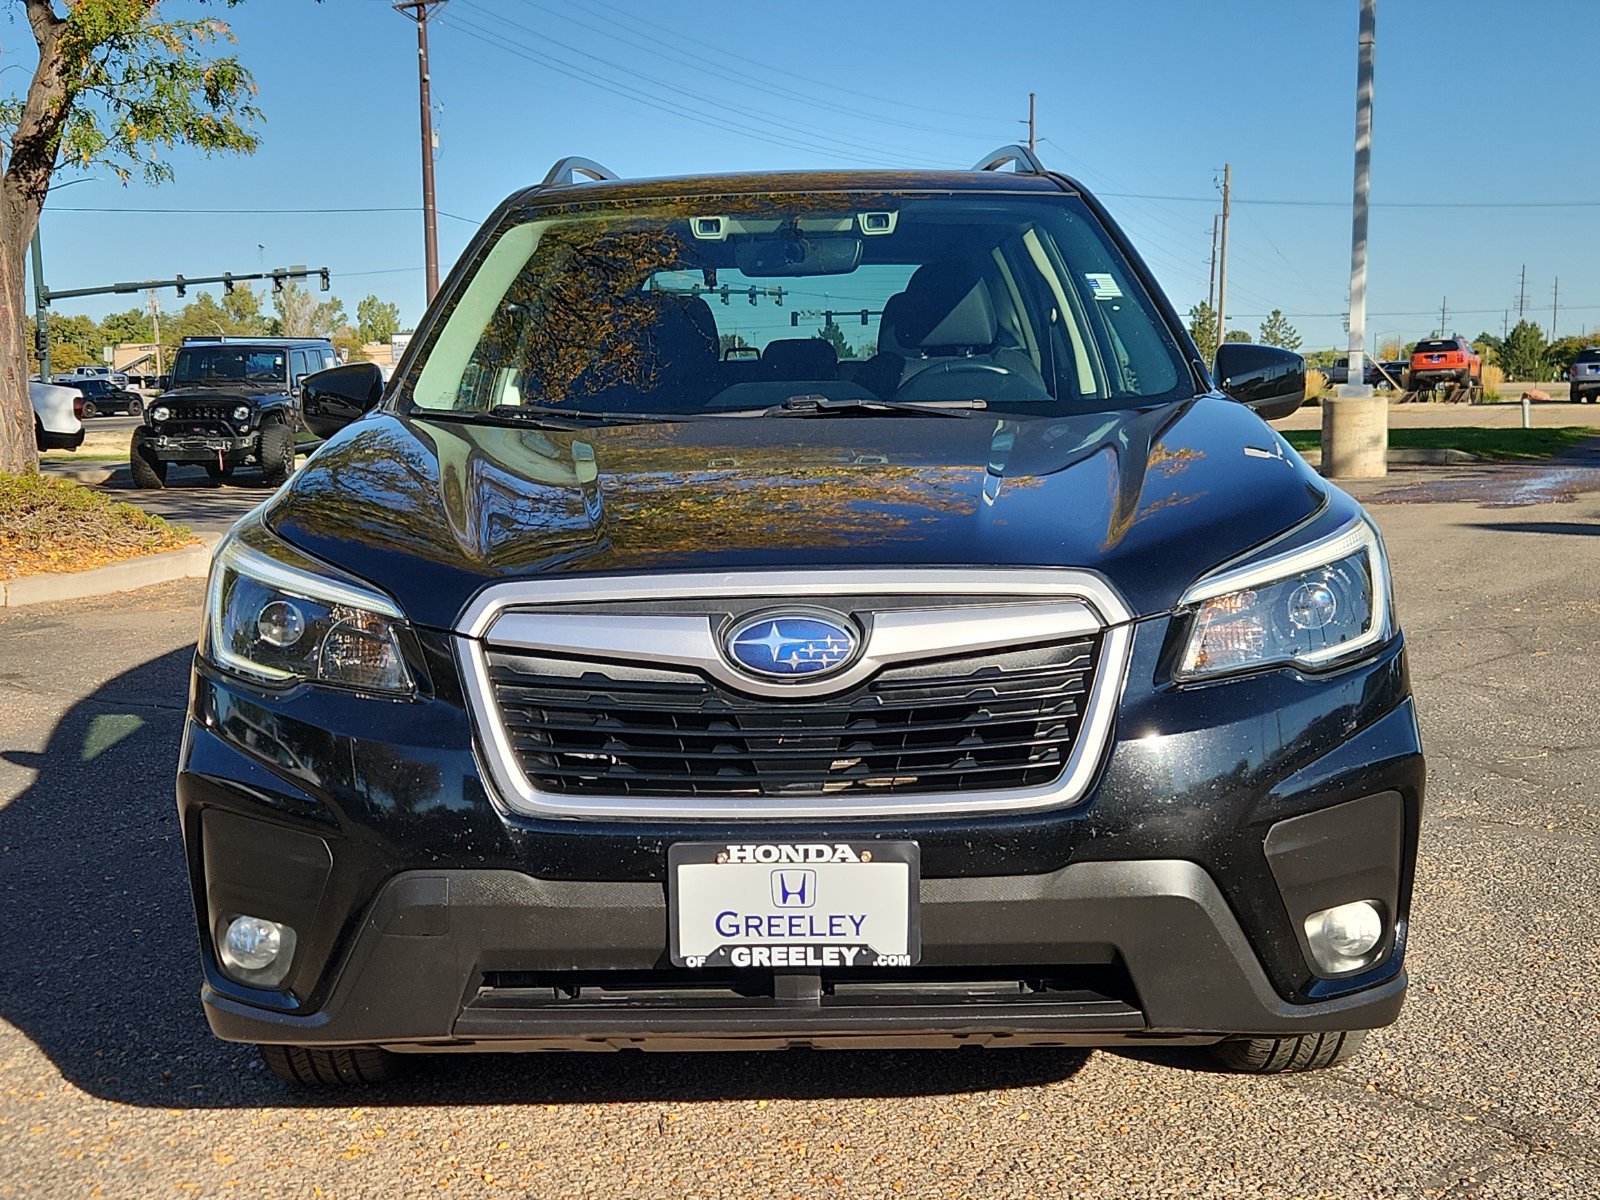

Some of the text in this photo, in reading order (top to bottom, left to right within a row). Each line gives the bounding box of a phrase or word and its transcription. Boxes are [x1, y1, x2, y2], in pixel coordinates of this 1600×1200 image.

[727, 844, 860, 863] HONDA
[715, 911, 868, 938] GREELEY
[686, 947, 911, 968] OF GREELEY .COM
